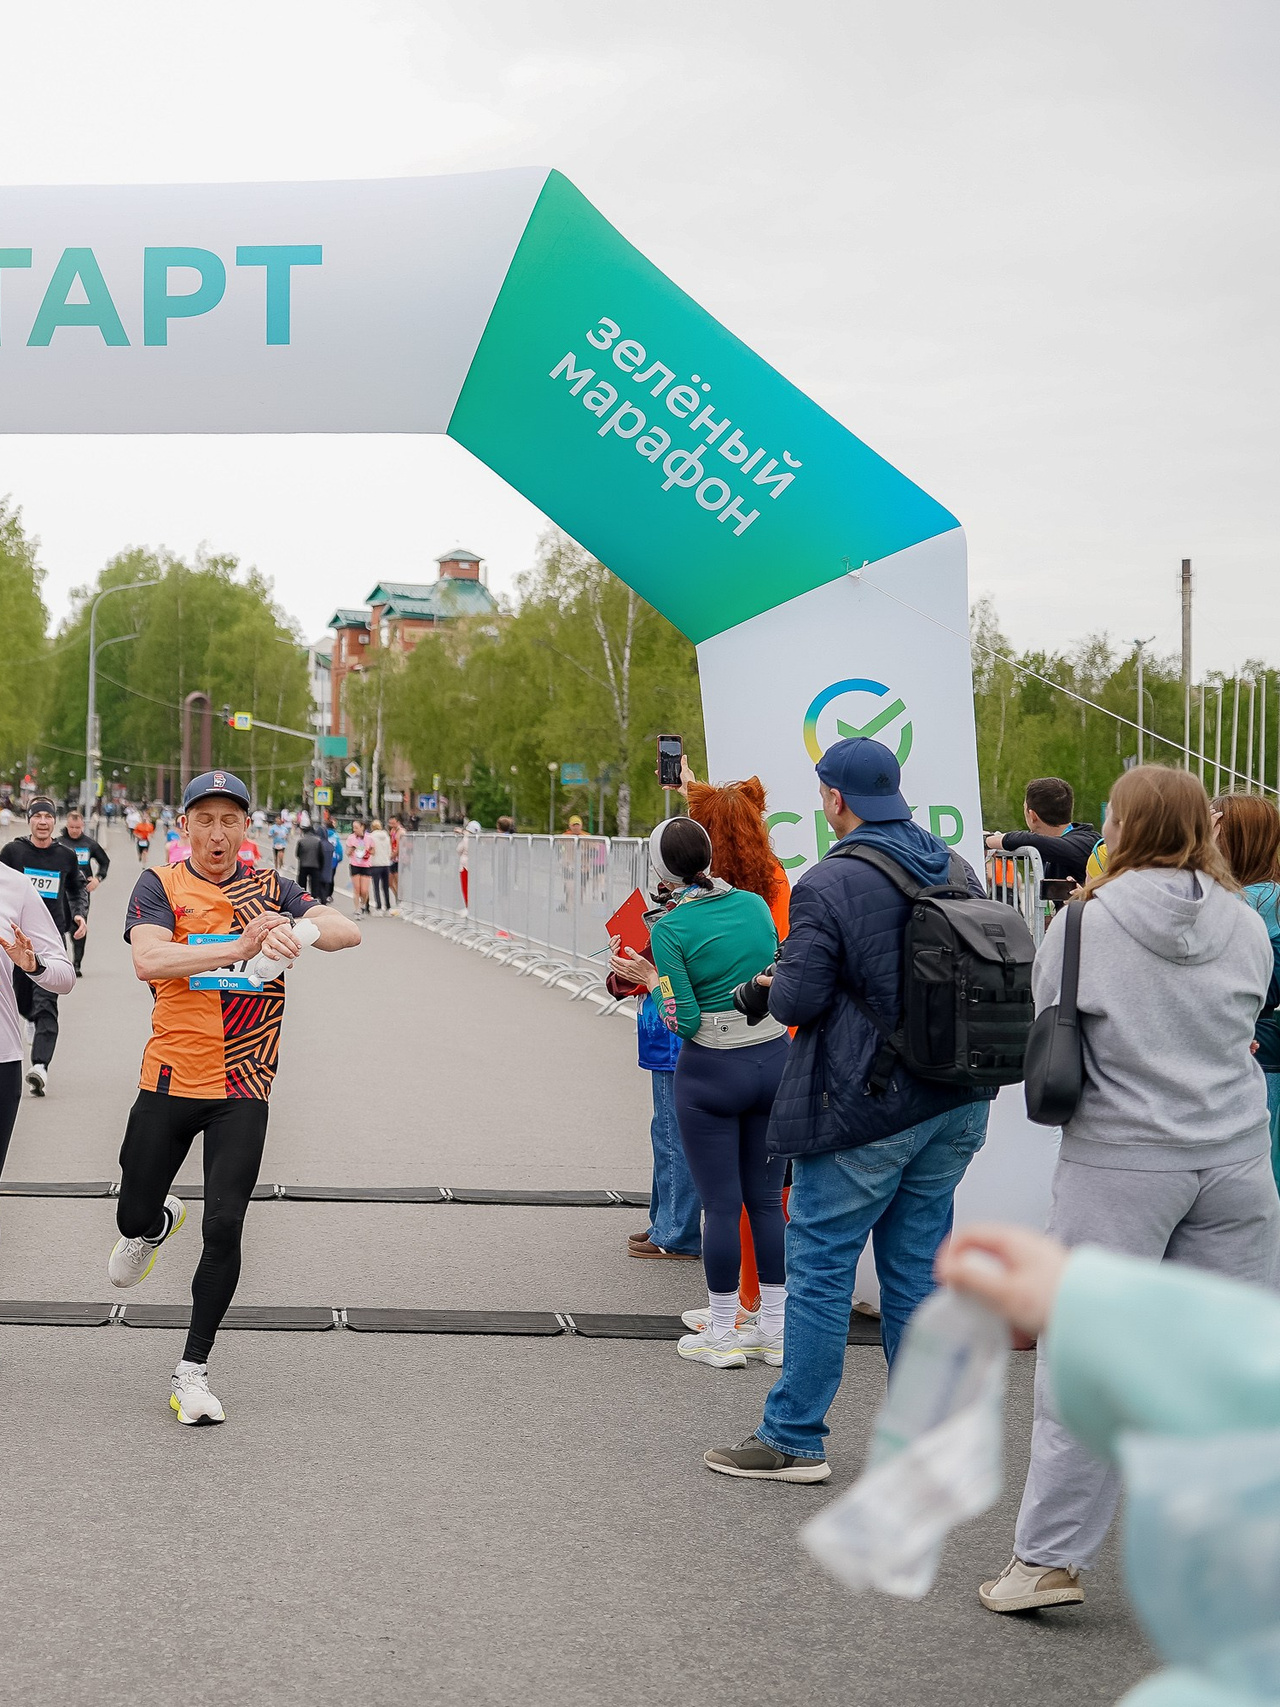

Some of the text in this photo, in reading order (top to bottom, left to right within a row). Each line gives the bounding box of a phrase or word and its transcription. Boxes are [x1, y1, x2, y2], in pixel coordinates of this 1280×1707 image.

[548, 351, 761, 537] марафон
[585, 316, 803, 500] зелёный
[30, 877, 52, 890] 787
